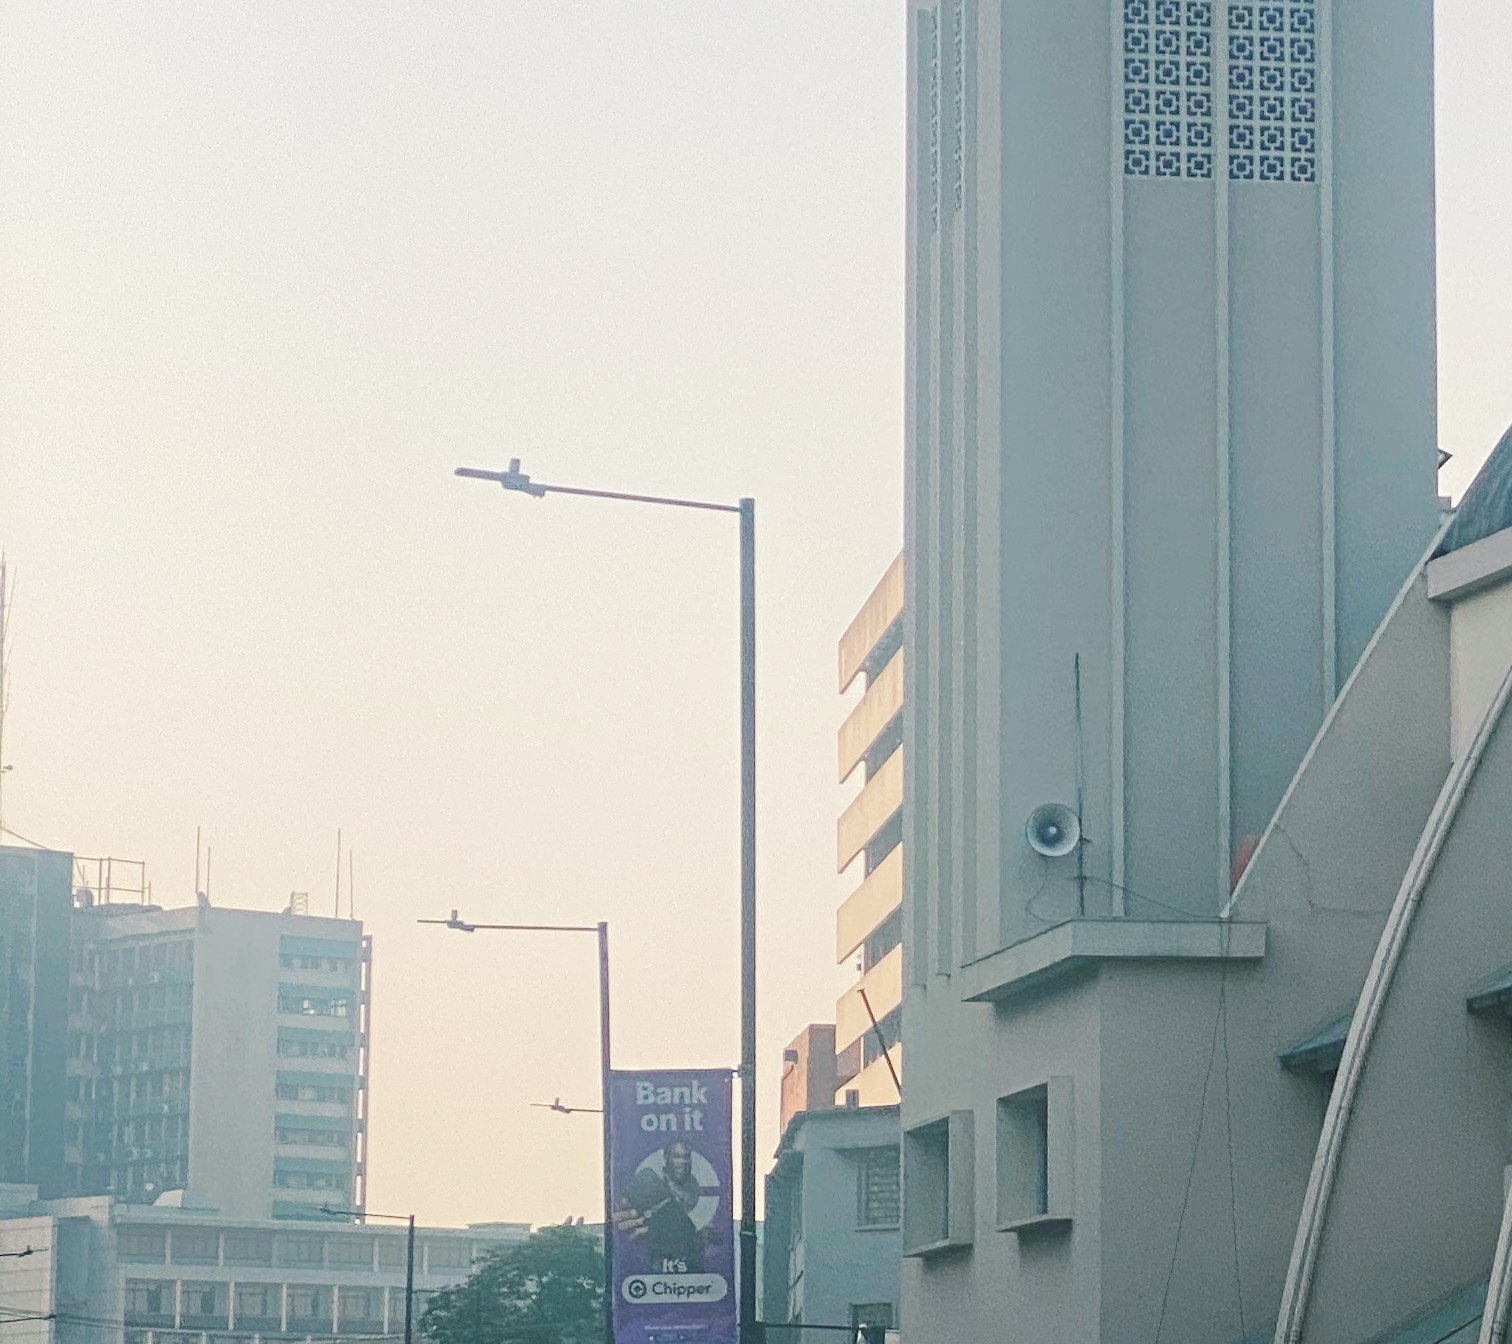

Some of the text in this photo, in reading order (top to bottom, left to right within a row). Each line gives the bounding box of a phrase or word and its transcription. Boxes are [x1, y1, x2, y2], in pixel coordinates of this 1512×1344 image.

[635, 1080, 708, 1105] Bank
[640, 1107, 704, 1131] on it
[652, 1282, 713, 1298] Chipper
